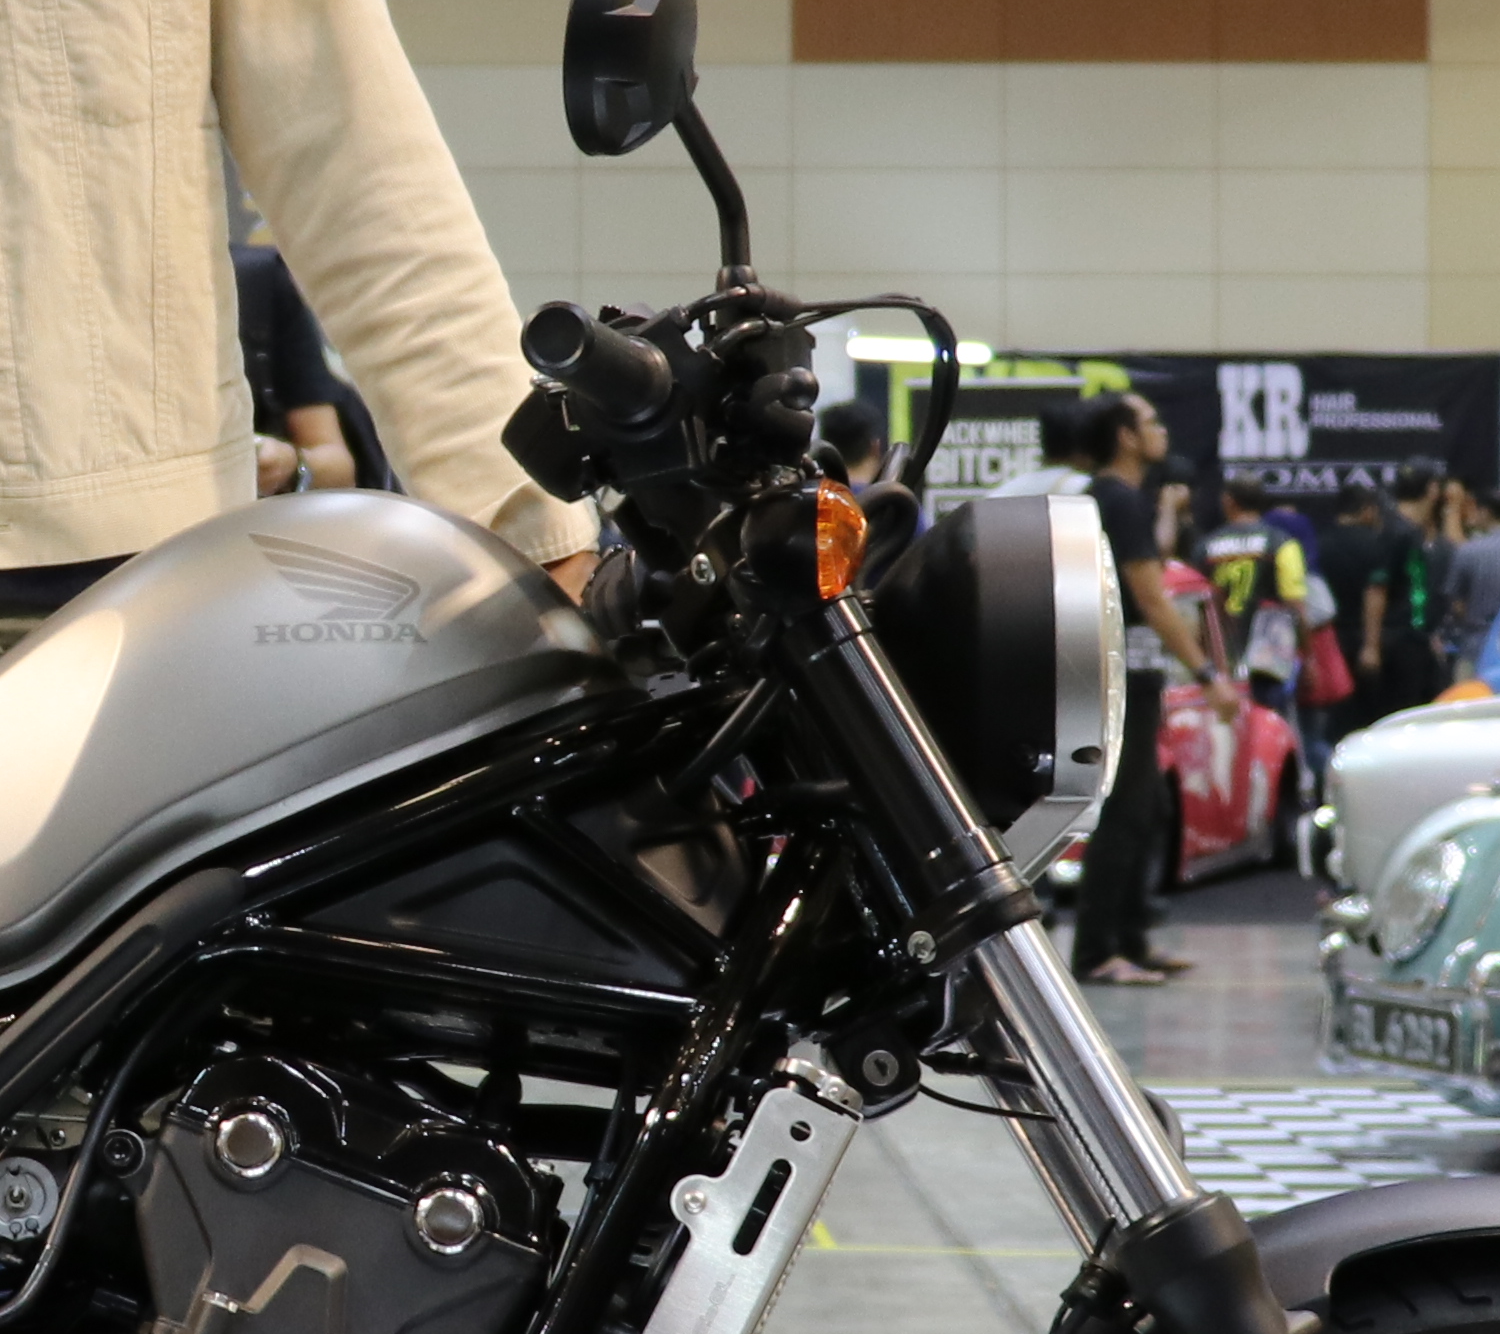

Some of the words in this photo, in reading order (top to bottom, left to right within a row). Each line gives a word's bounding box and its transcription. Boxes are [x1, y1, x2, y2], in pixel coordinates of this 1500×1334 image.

[1217, 363, 1309, 458] KR
[924, 447, 1044, 485] BITCHE
[254, 622, 428, 645] HONDA
